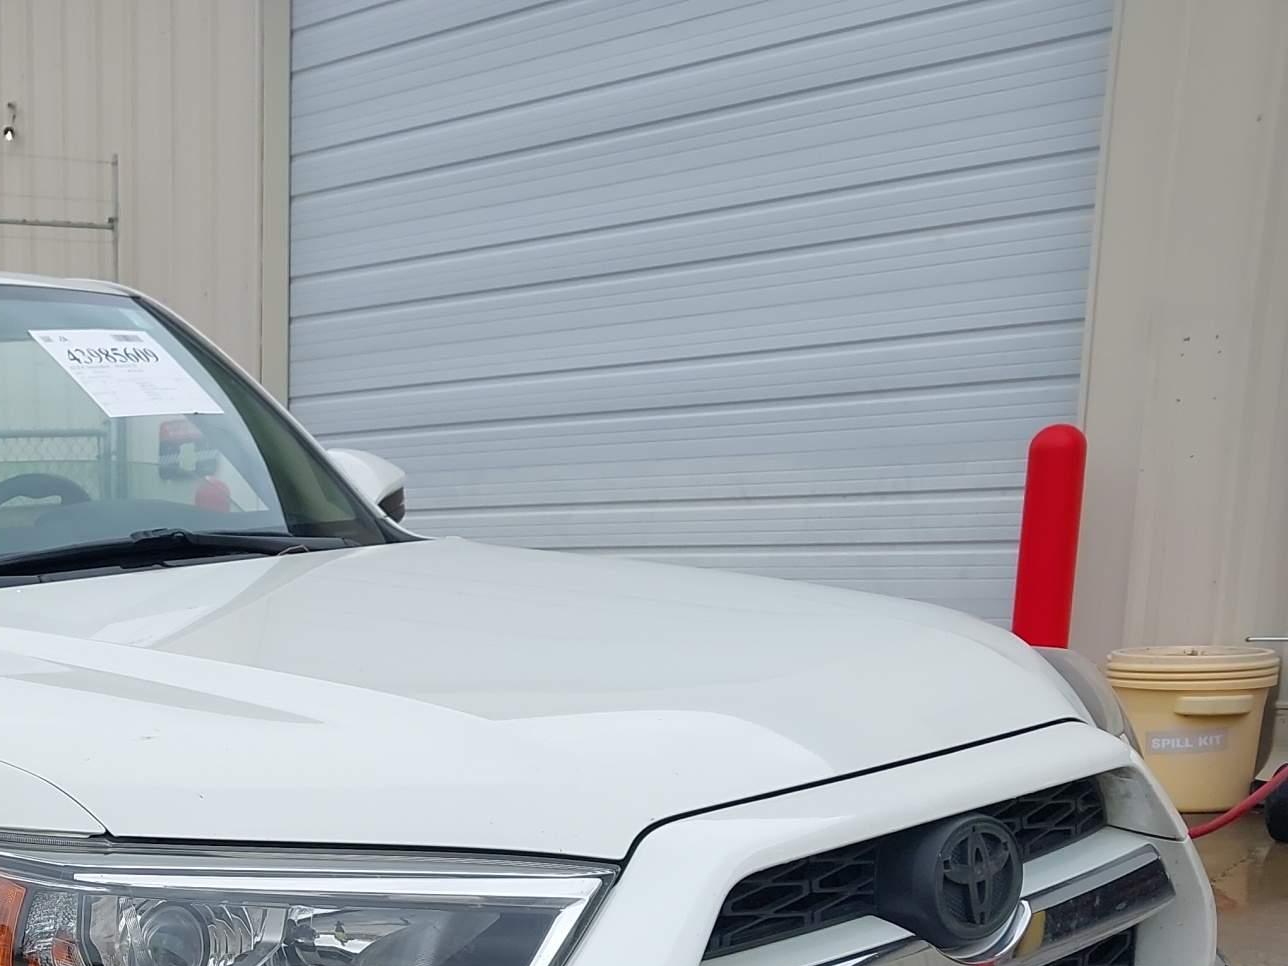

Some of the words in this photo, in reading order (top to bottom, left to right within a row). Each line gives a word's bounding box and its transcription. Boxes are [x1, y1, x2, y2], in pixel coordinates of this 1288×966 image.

[67, 347, 159, 364] 43985609
[1151, 737, 1193, 750] SPILL
[1198, 734, 1223, 747] KIT
